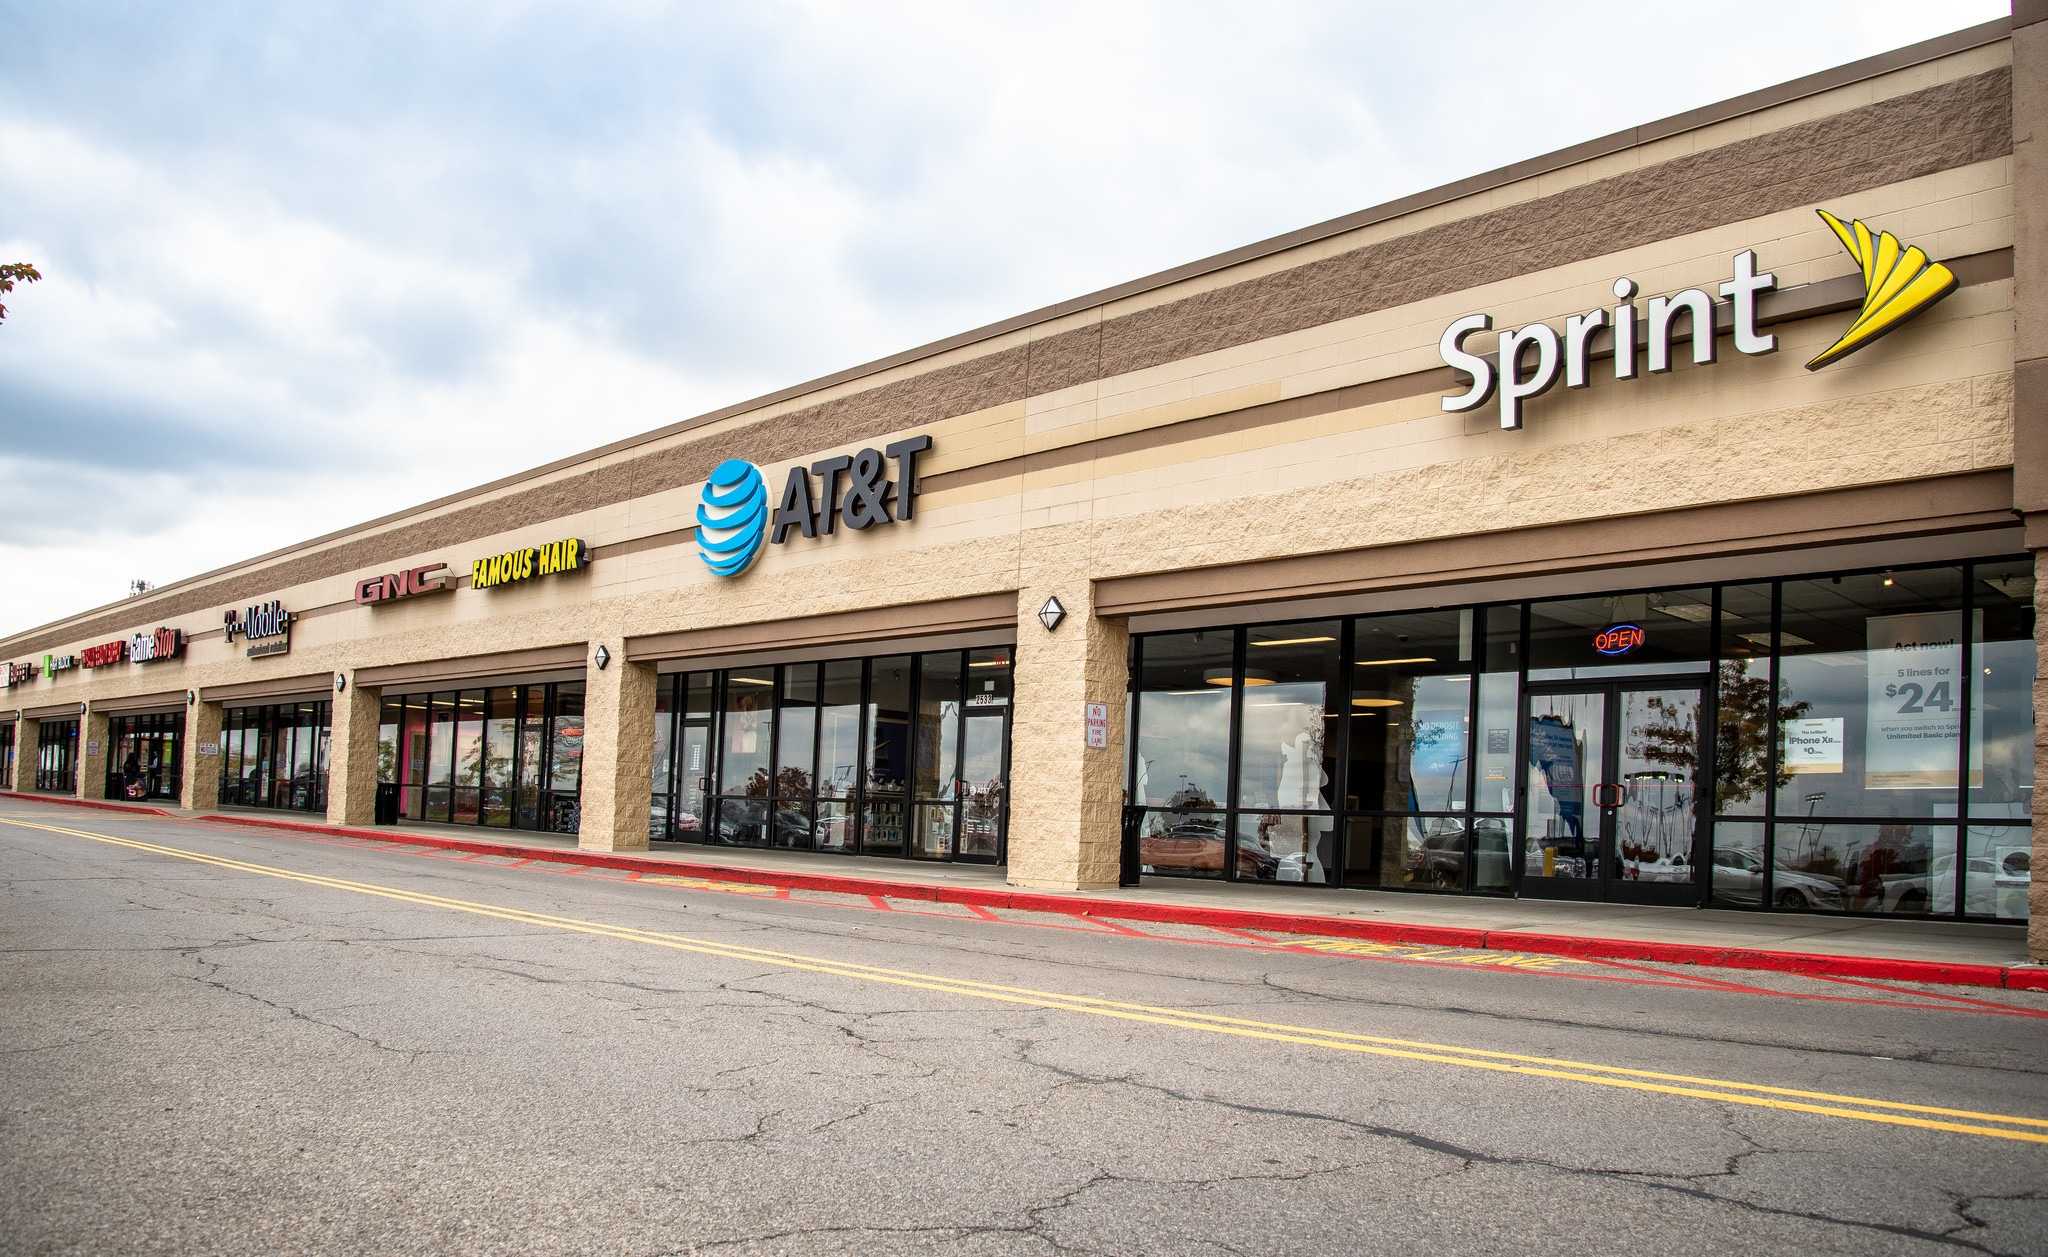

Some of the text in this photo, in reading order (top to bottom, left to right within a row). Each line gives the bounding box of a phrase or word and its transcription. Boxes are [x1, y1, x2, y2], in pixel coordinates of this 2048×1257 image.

[1439, 249, 1778, 430] Sprint
[771, 435, 932, 544] AT&T
[471, 538, 584, 590] FAMOUS HAIR
[355, 563, 447, 604] GNC
[130, 627, 178, 663] GameStop
[1595, 629, 1643, 649] OPEN
[1894, 639, 1954, 652] Act now!
[1898, 667, 1951, 677] 5 lines for
[976, 694, 993, 705] 2533
[1885, 681, 1954, 714] $24
[1092, 707, 1102, 716] NO
[1088, 717, 1106, 728] PARKING
[1789, 737, 1820, 745] iPhone
